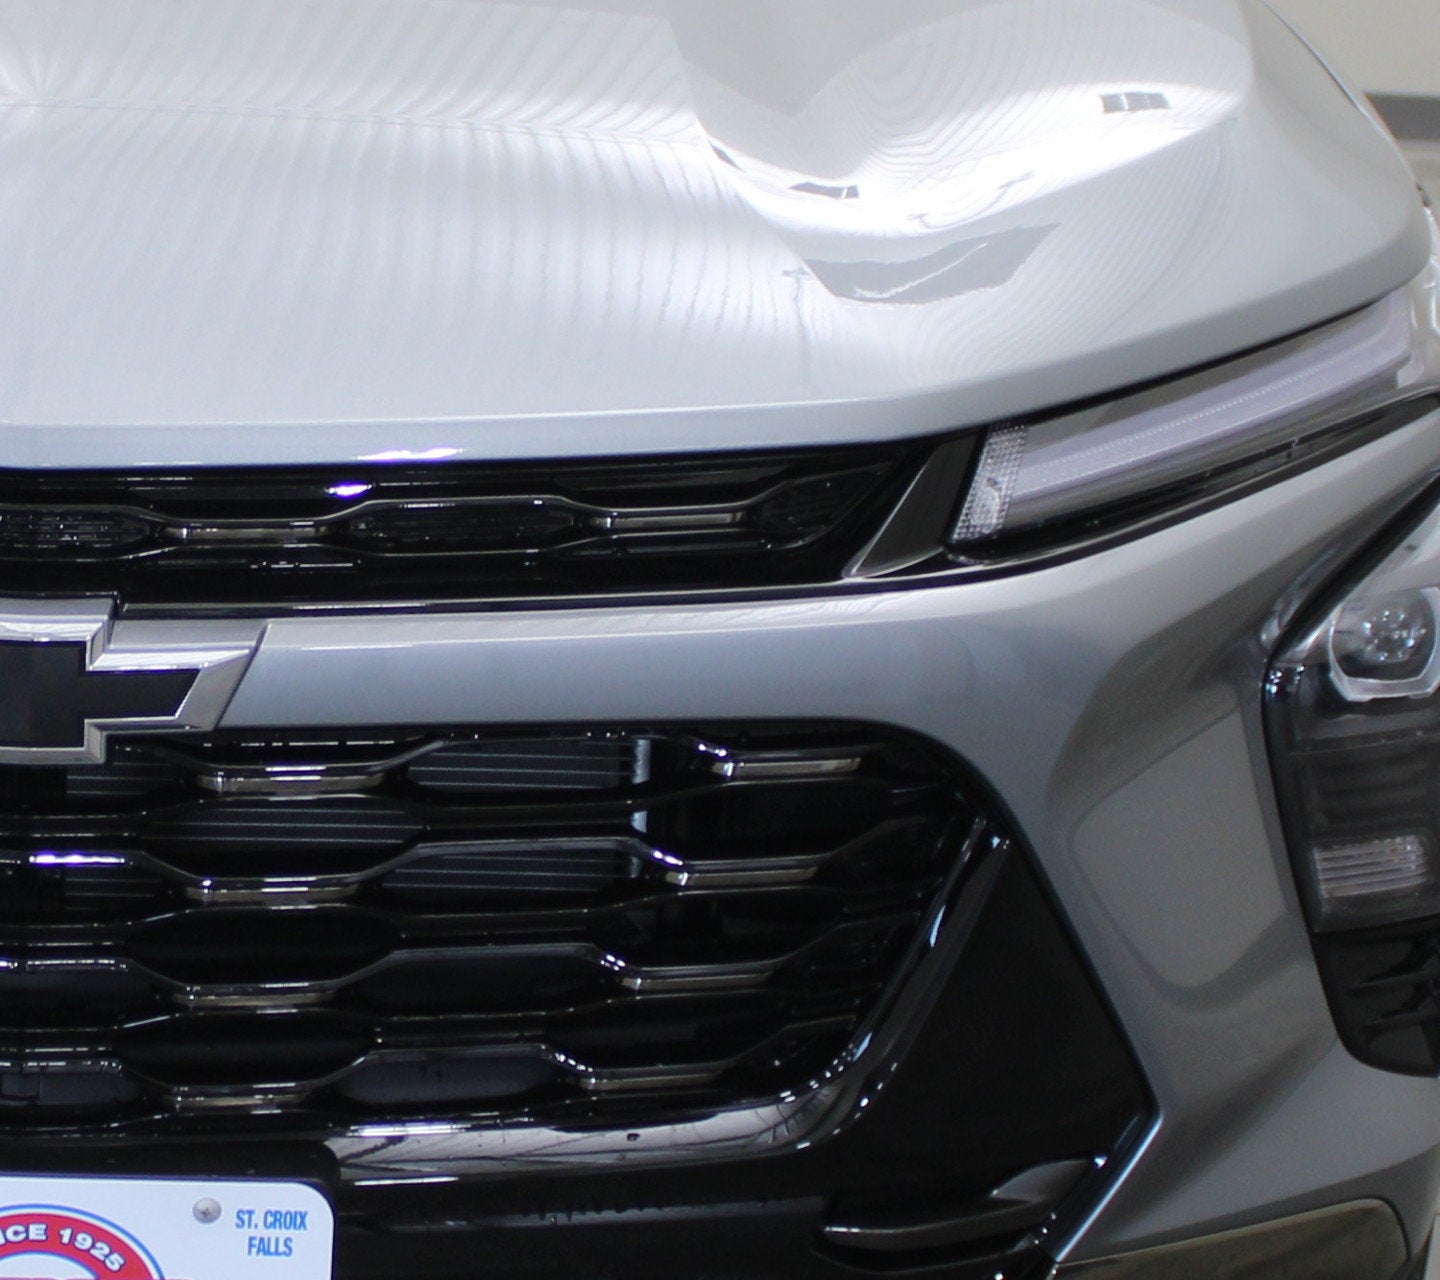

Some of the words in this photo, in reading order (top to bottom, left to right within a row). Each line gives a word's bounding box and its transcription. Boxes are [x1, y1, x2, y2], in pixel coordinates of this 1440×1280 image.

[235, 1209, 258, 1230] ST.
[263, 1210, 308, 1230] CROIX
[59, 1227, 126, 1272] 1925
[247, 1236, 293, 1257] FALLS
